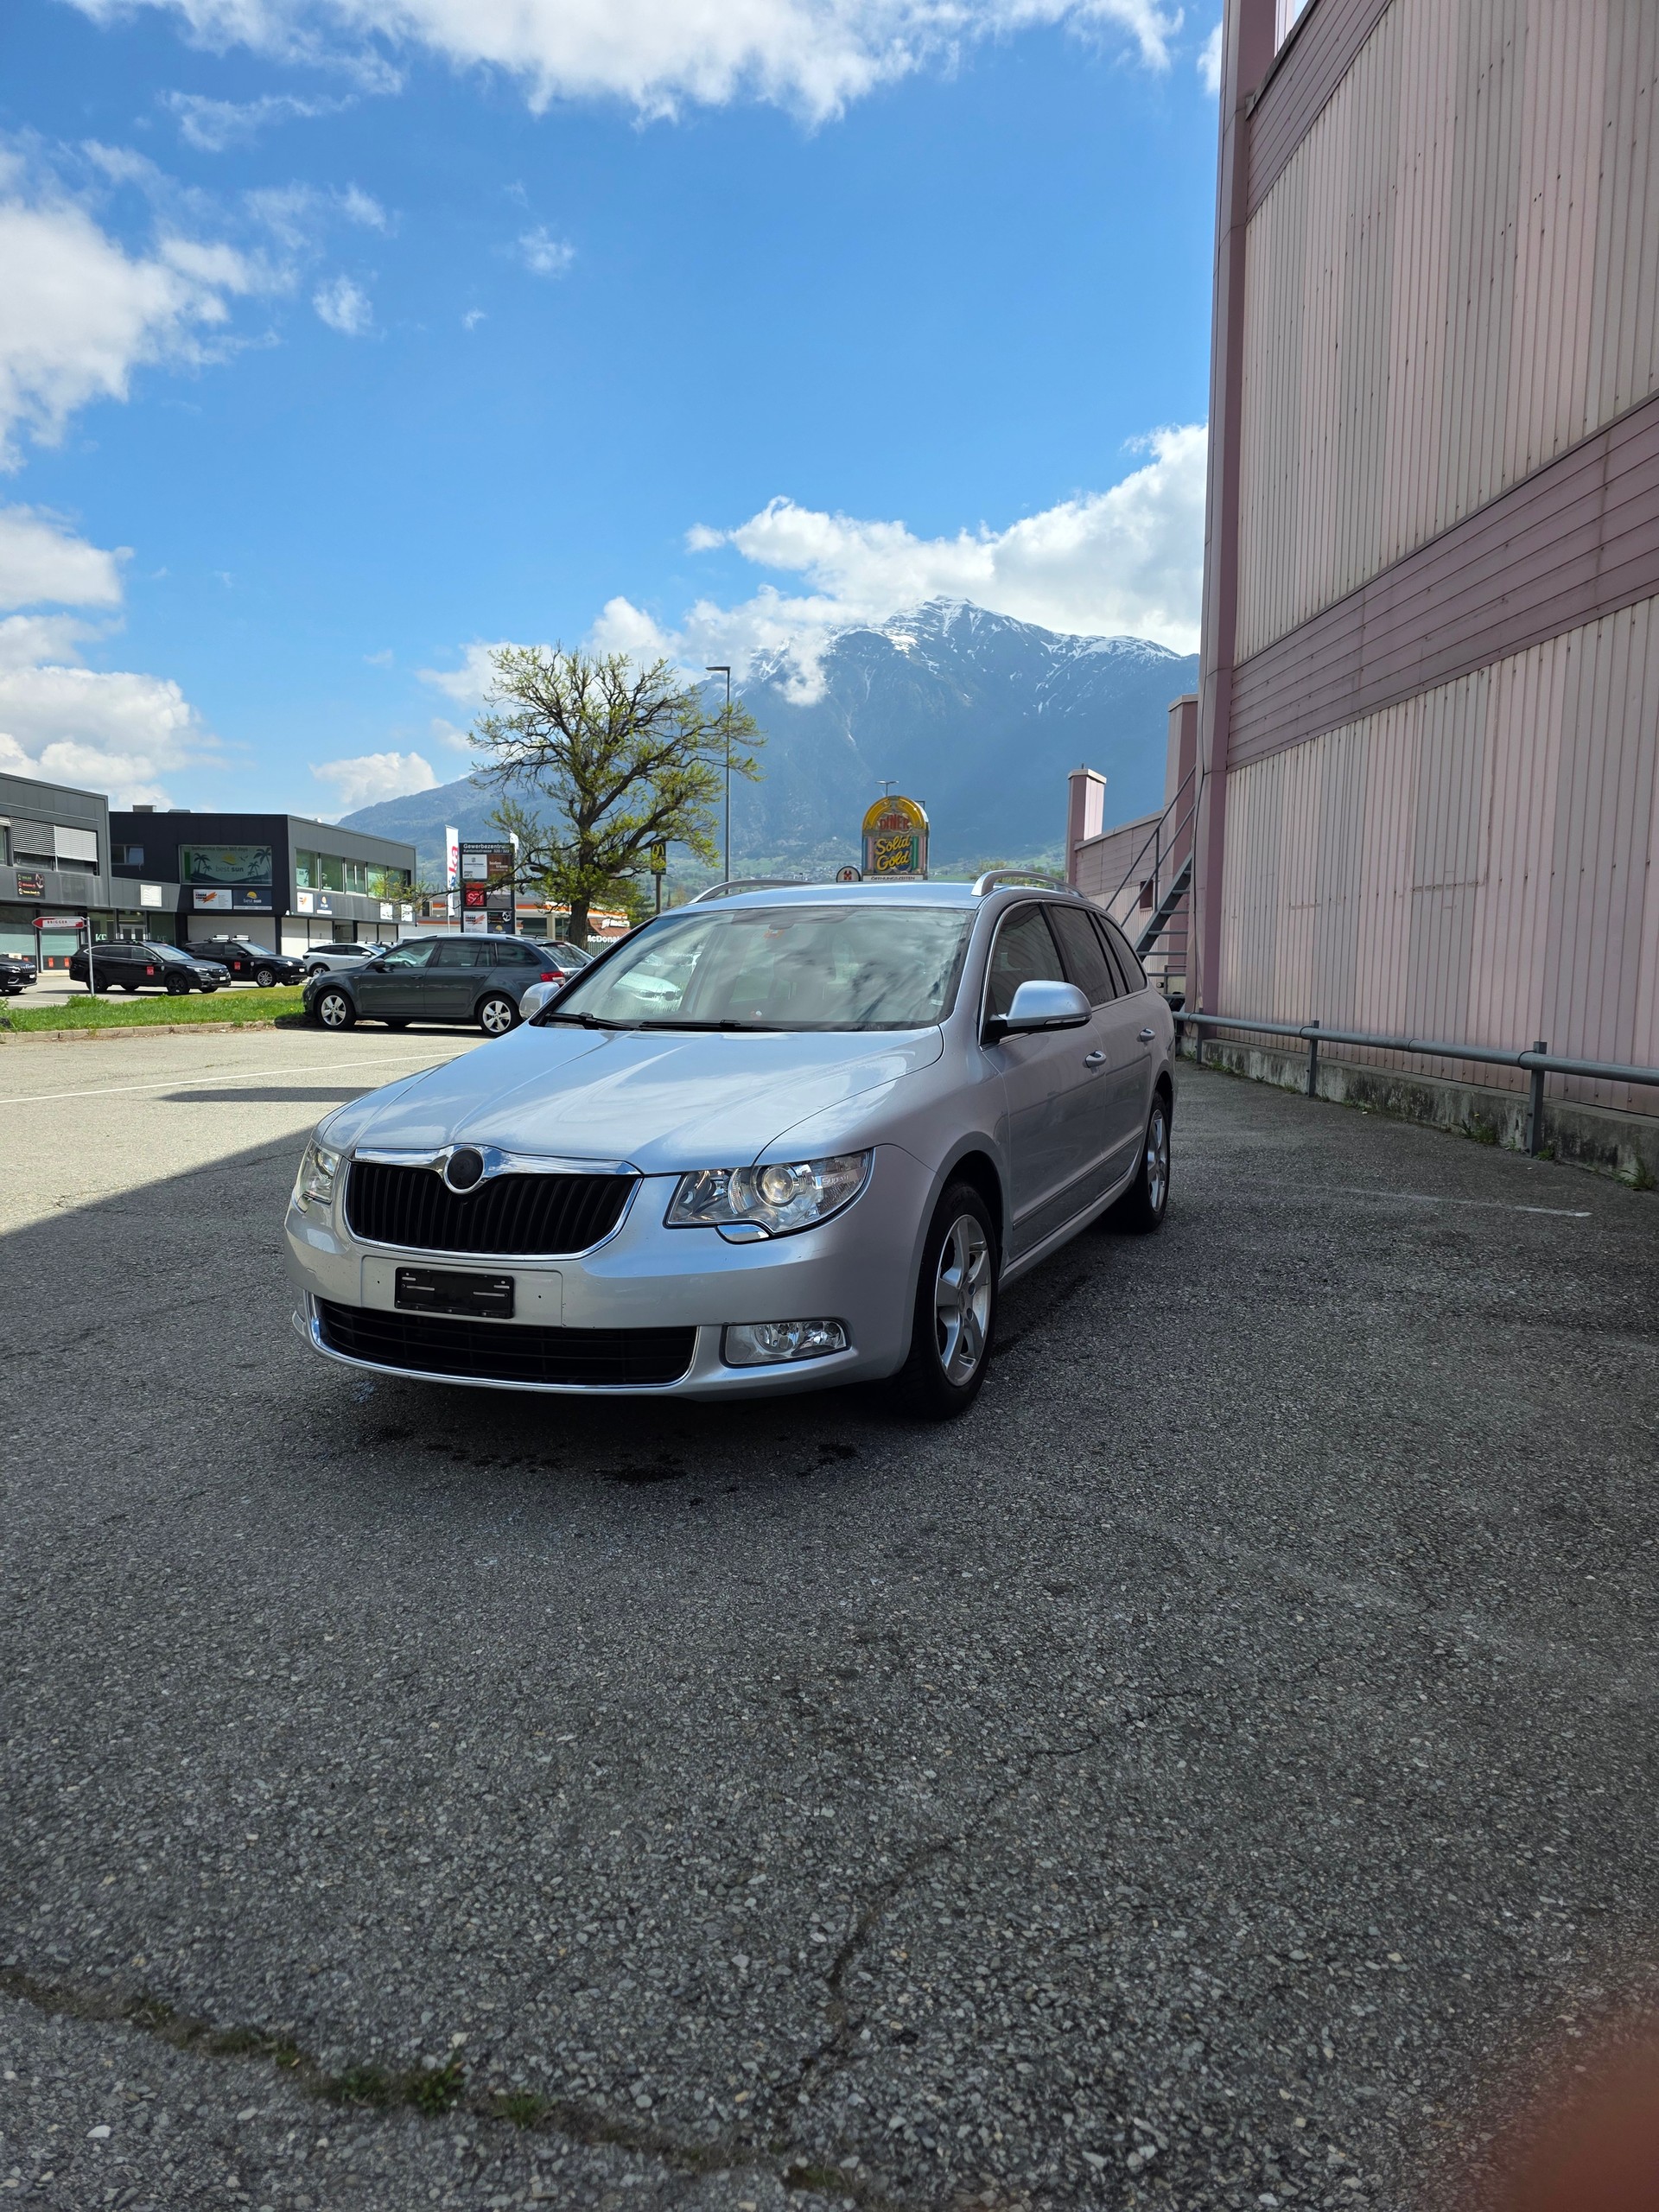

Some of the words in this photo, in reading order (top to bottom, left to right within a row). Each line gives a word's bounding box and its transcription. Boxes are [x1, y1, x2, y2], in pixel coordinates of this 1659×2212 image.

[880, 814, 910, 830] DINER
[874, 835, 912, 855] Solid
[876, 850, 910, 871] Gold
